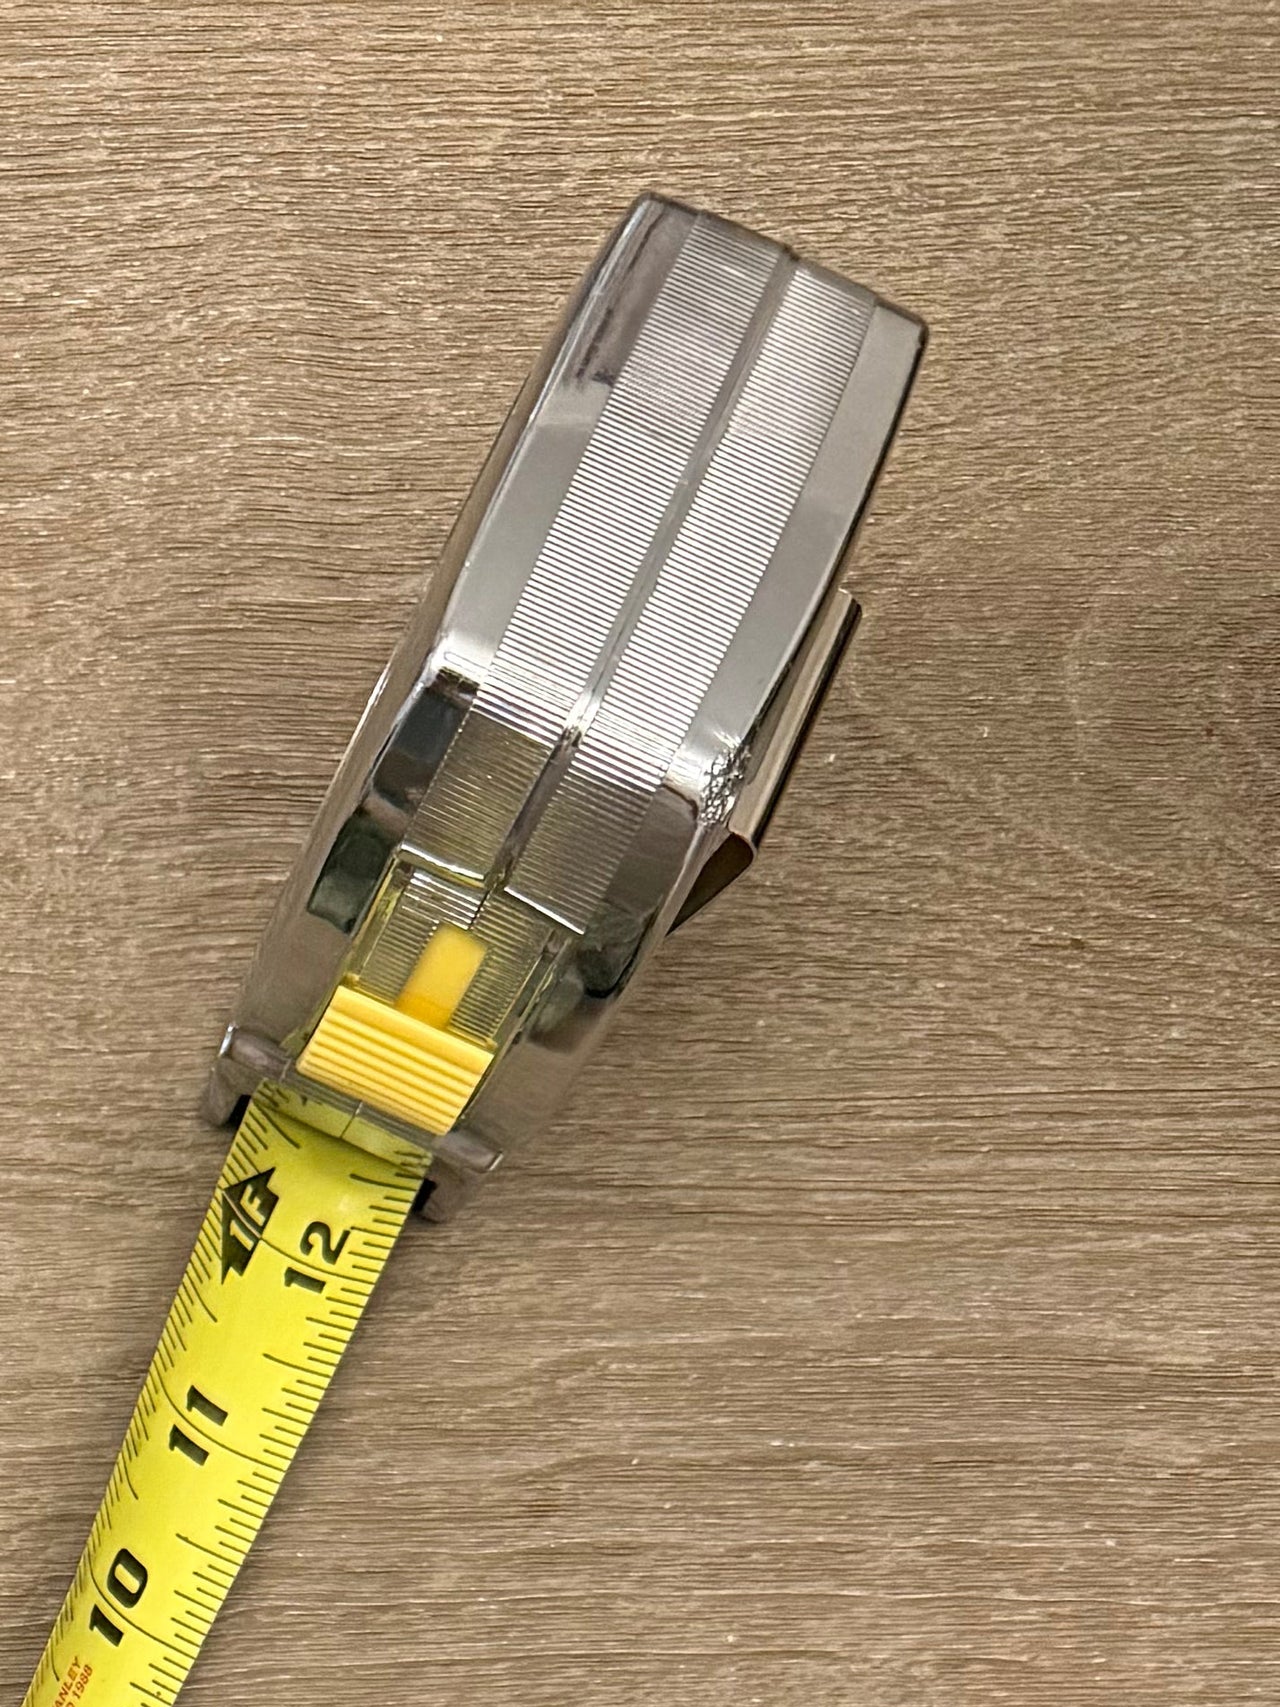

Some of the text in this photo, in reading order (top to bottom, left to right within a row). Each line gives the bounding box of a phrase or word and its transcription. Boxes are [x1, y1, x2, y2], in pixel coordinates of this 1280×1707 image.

[283, 1220, 352, 1294] 12
[168, 1384, 229, 1467] 11
[89, 1548, 149, 1648] 10
[72, 1664, 93, 1700] 1988
